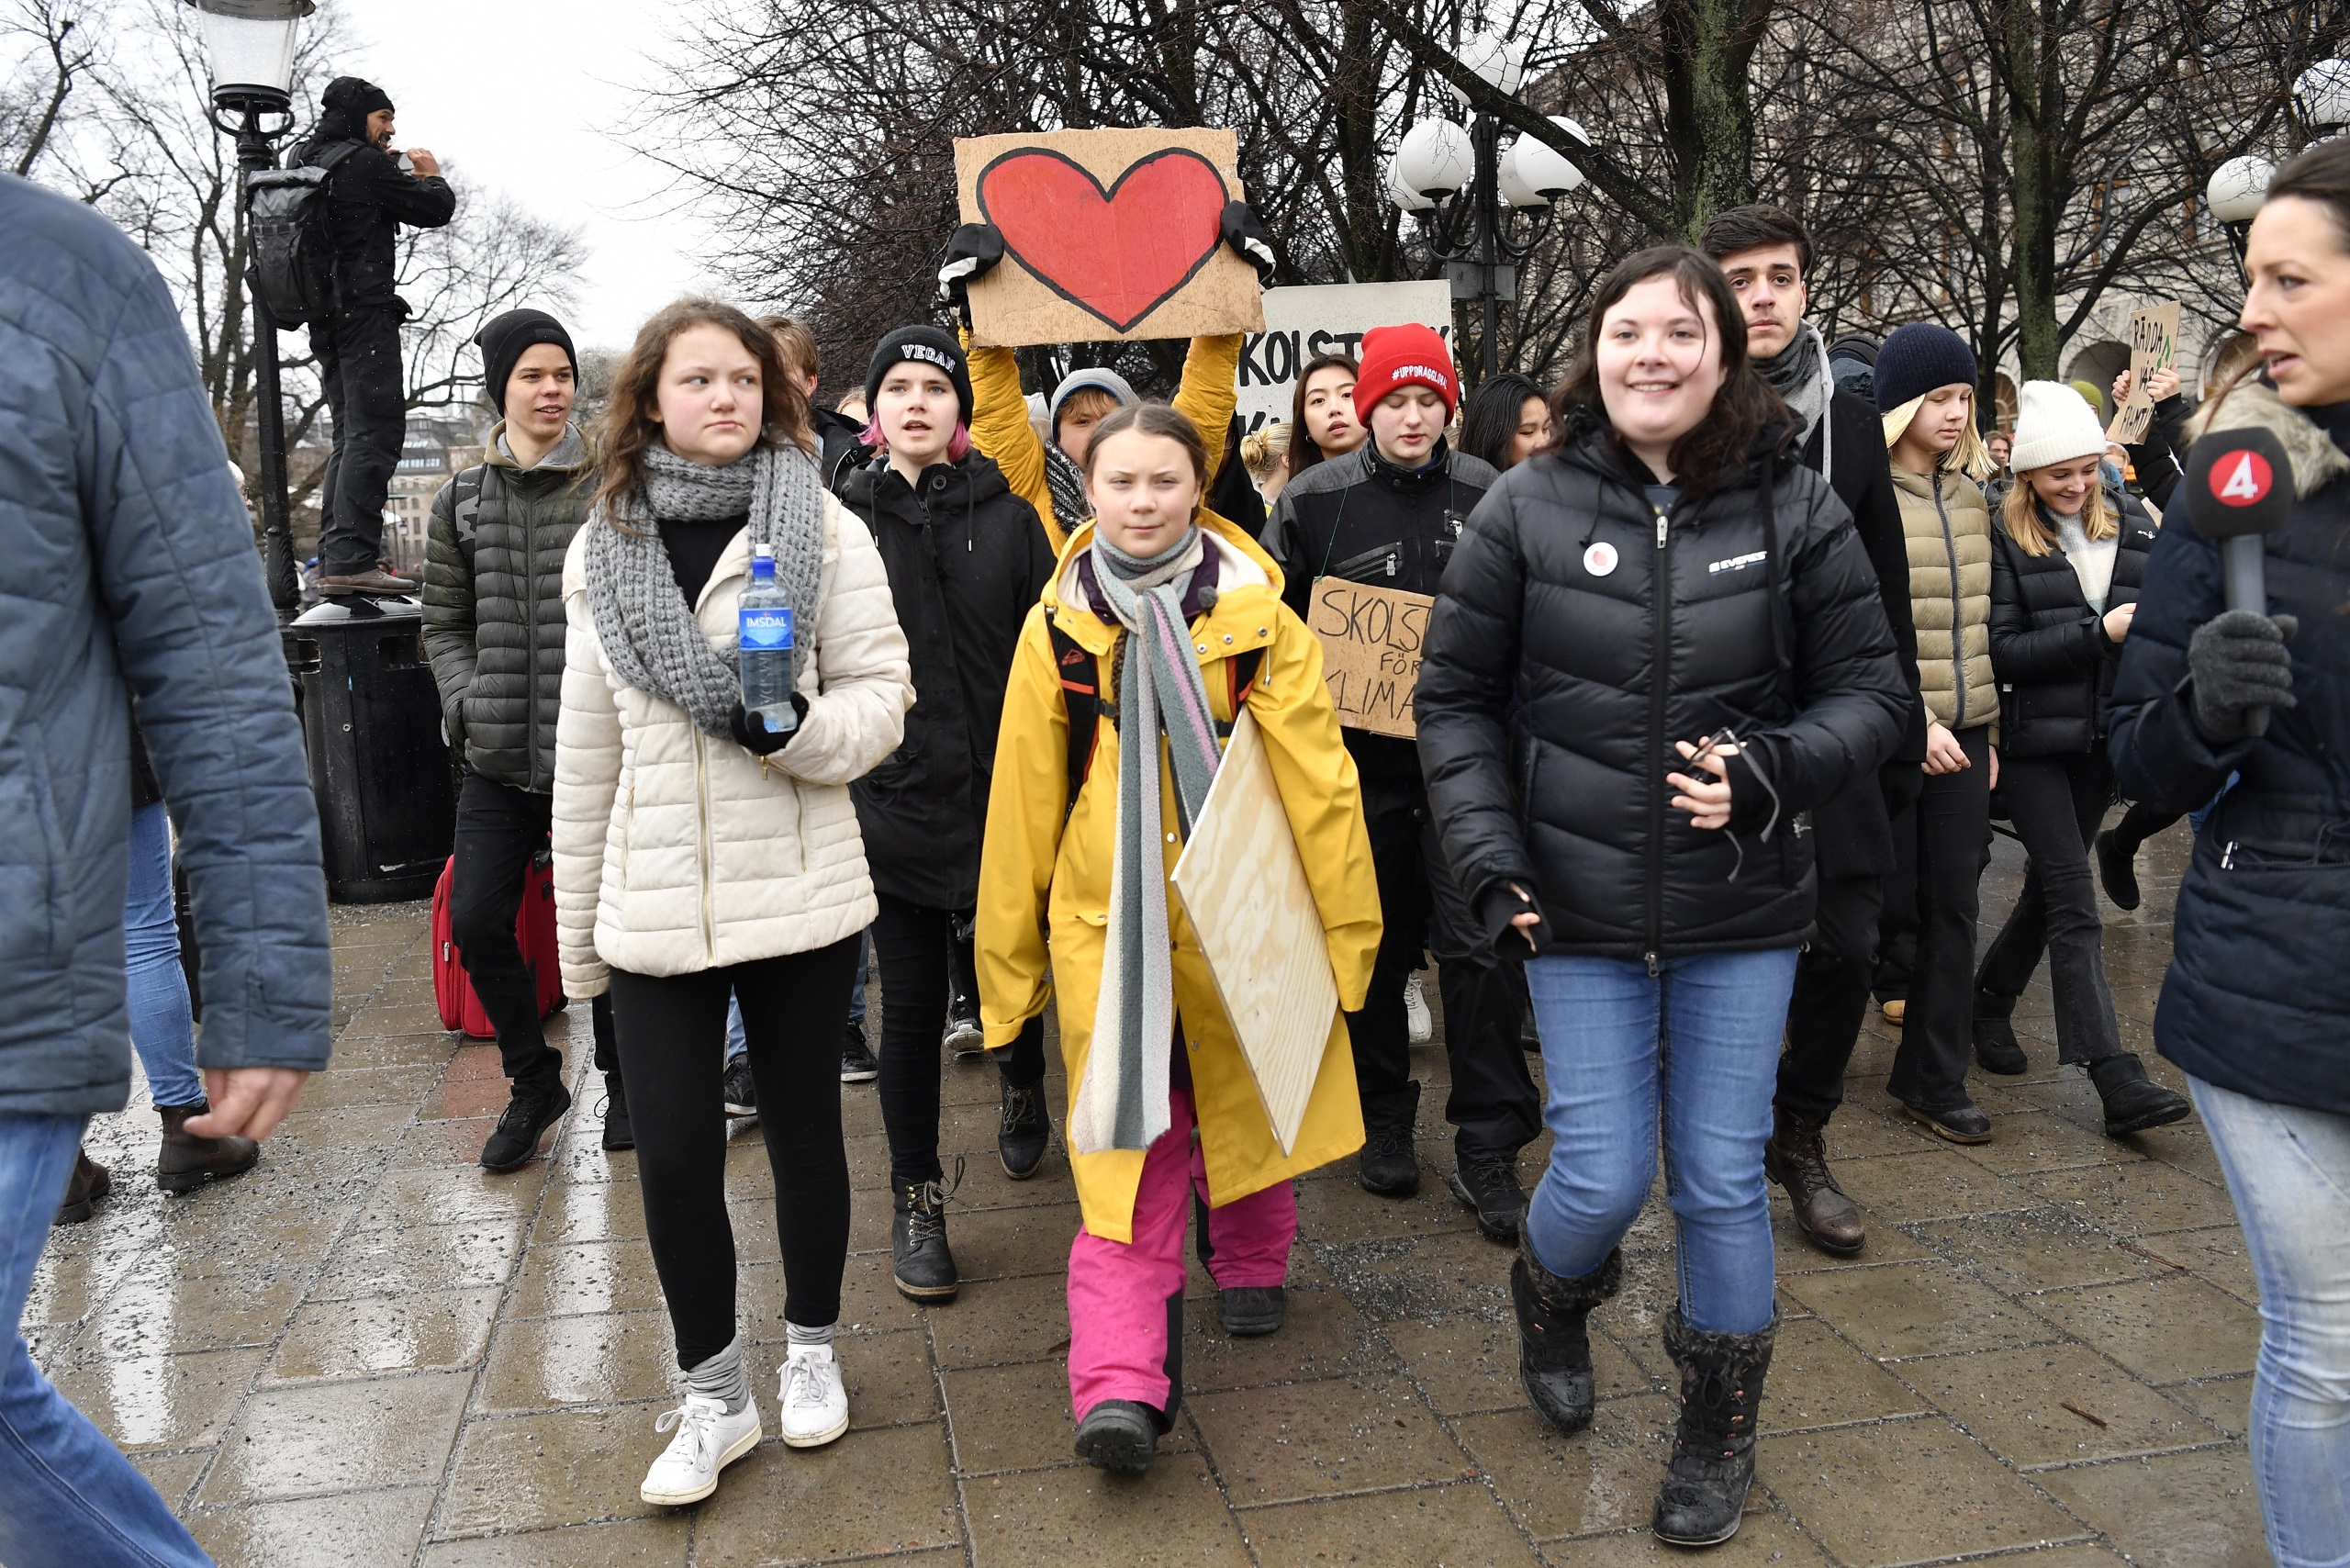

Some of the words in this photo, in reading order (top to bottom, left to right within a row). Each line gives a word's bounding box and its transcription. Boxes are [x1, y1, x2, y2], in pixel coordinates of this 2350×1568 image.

[901, 343, 956, 374] VEGAN
[2220, 451, 2259, 499] 4
[745, 616, 788, 628] IMSDAL
[1381, 652, 1422, 677] FÖR
